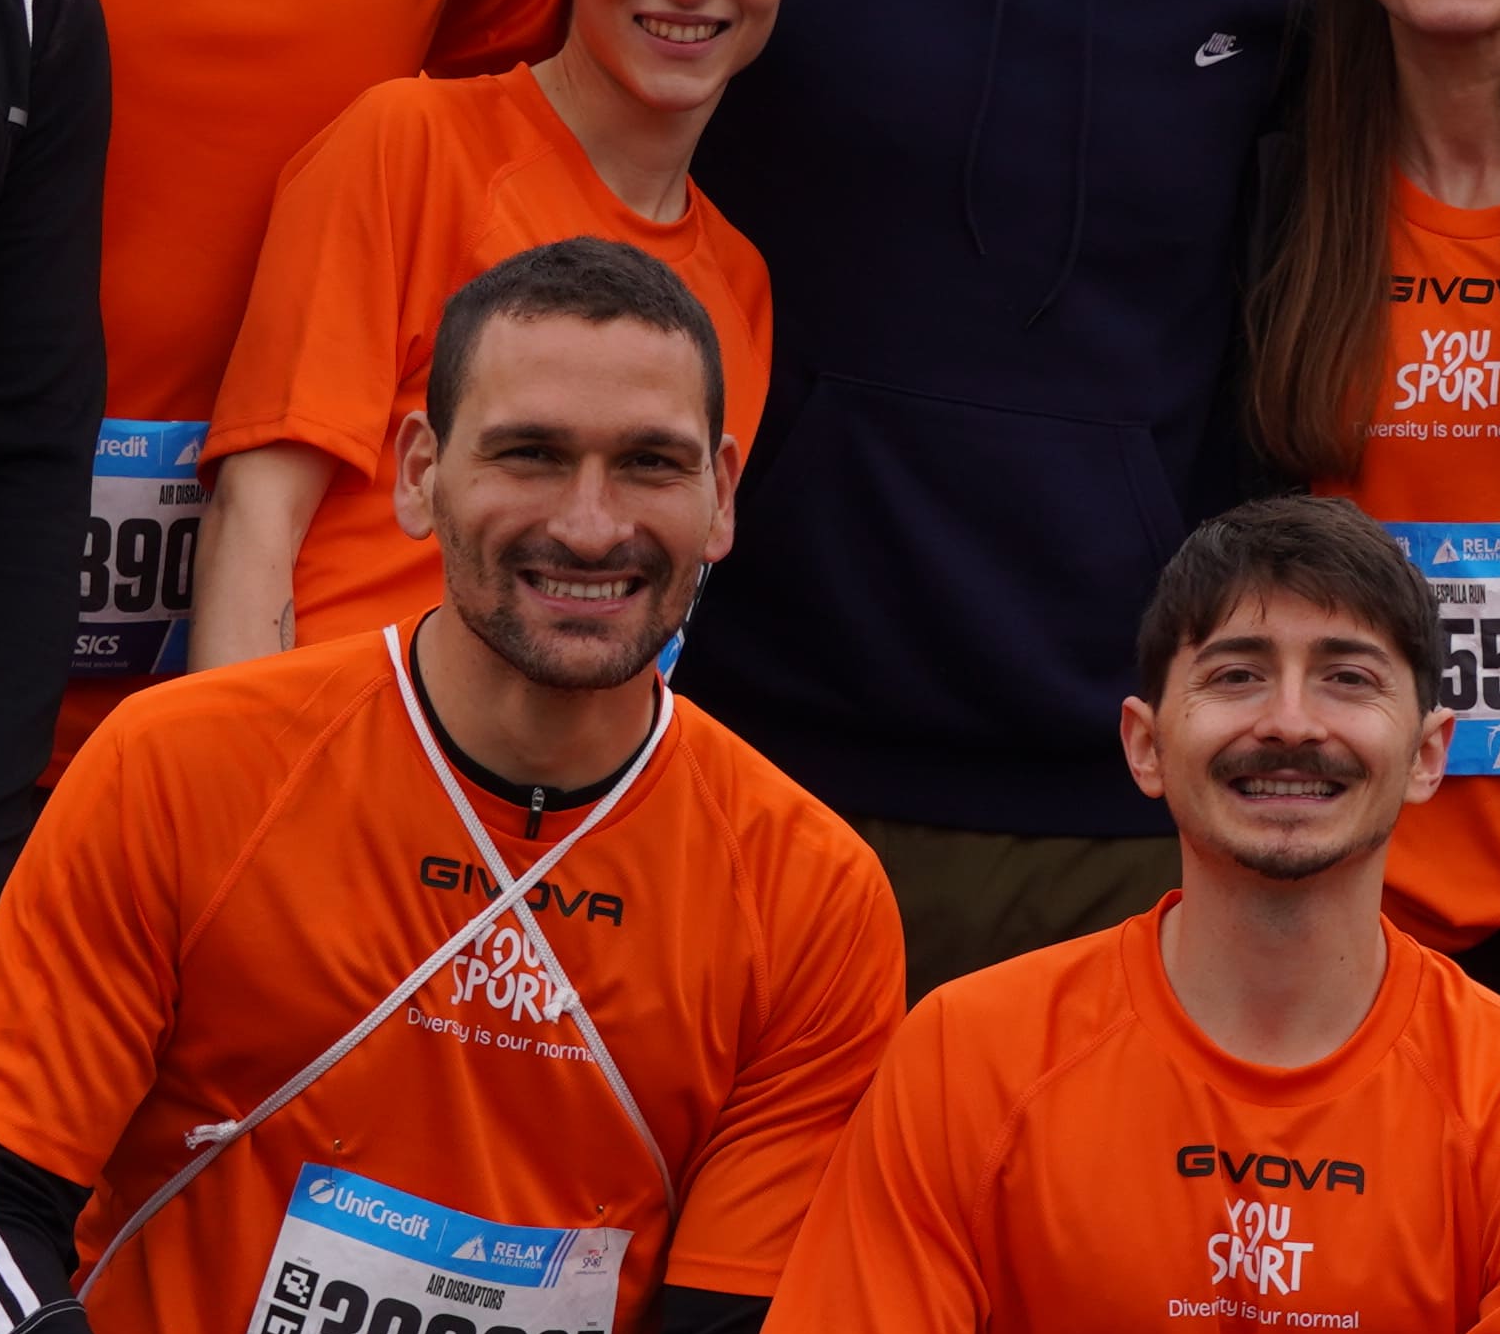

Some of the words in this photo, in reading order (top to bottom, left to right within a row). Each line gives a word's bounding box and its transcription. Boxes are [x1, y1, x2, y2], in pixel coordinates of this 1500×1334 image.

[1420, 329, 1492, 363] YOU
[1432, 421, 1448, 437] is
[1452, 424, 1482, 437] our
[475, 1025, 492, 1045] is
[496, 1032, 532, 1052] our
[536, 1040, 598, 1063] norma
[334, 1186, 430, 1240] UniCredit
[1225, 1197, 1291, 1241] YOU
[490, 1255, 542, 1270] MARATHON
[492, 1241, 547, 1262] RELAY
[1208, 1232, 1314, 1295] SPORT
[425, 1273, 443, 1297] AIR
[448, 1278, 506, 1311] DISRAPTORS
[1241, 1301, 1257, 1319] is
[1286, 1311, 1359, 1329] normal
